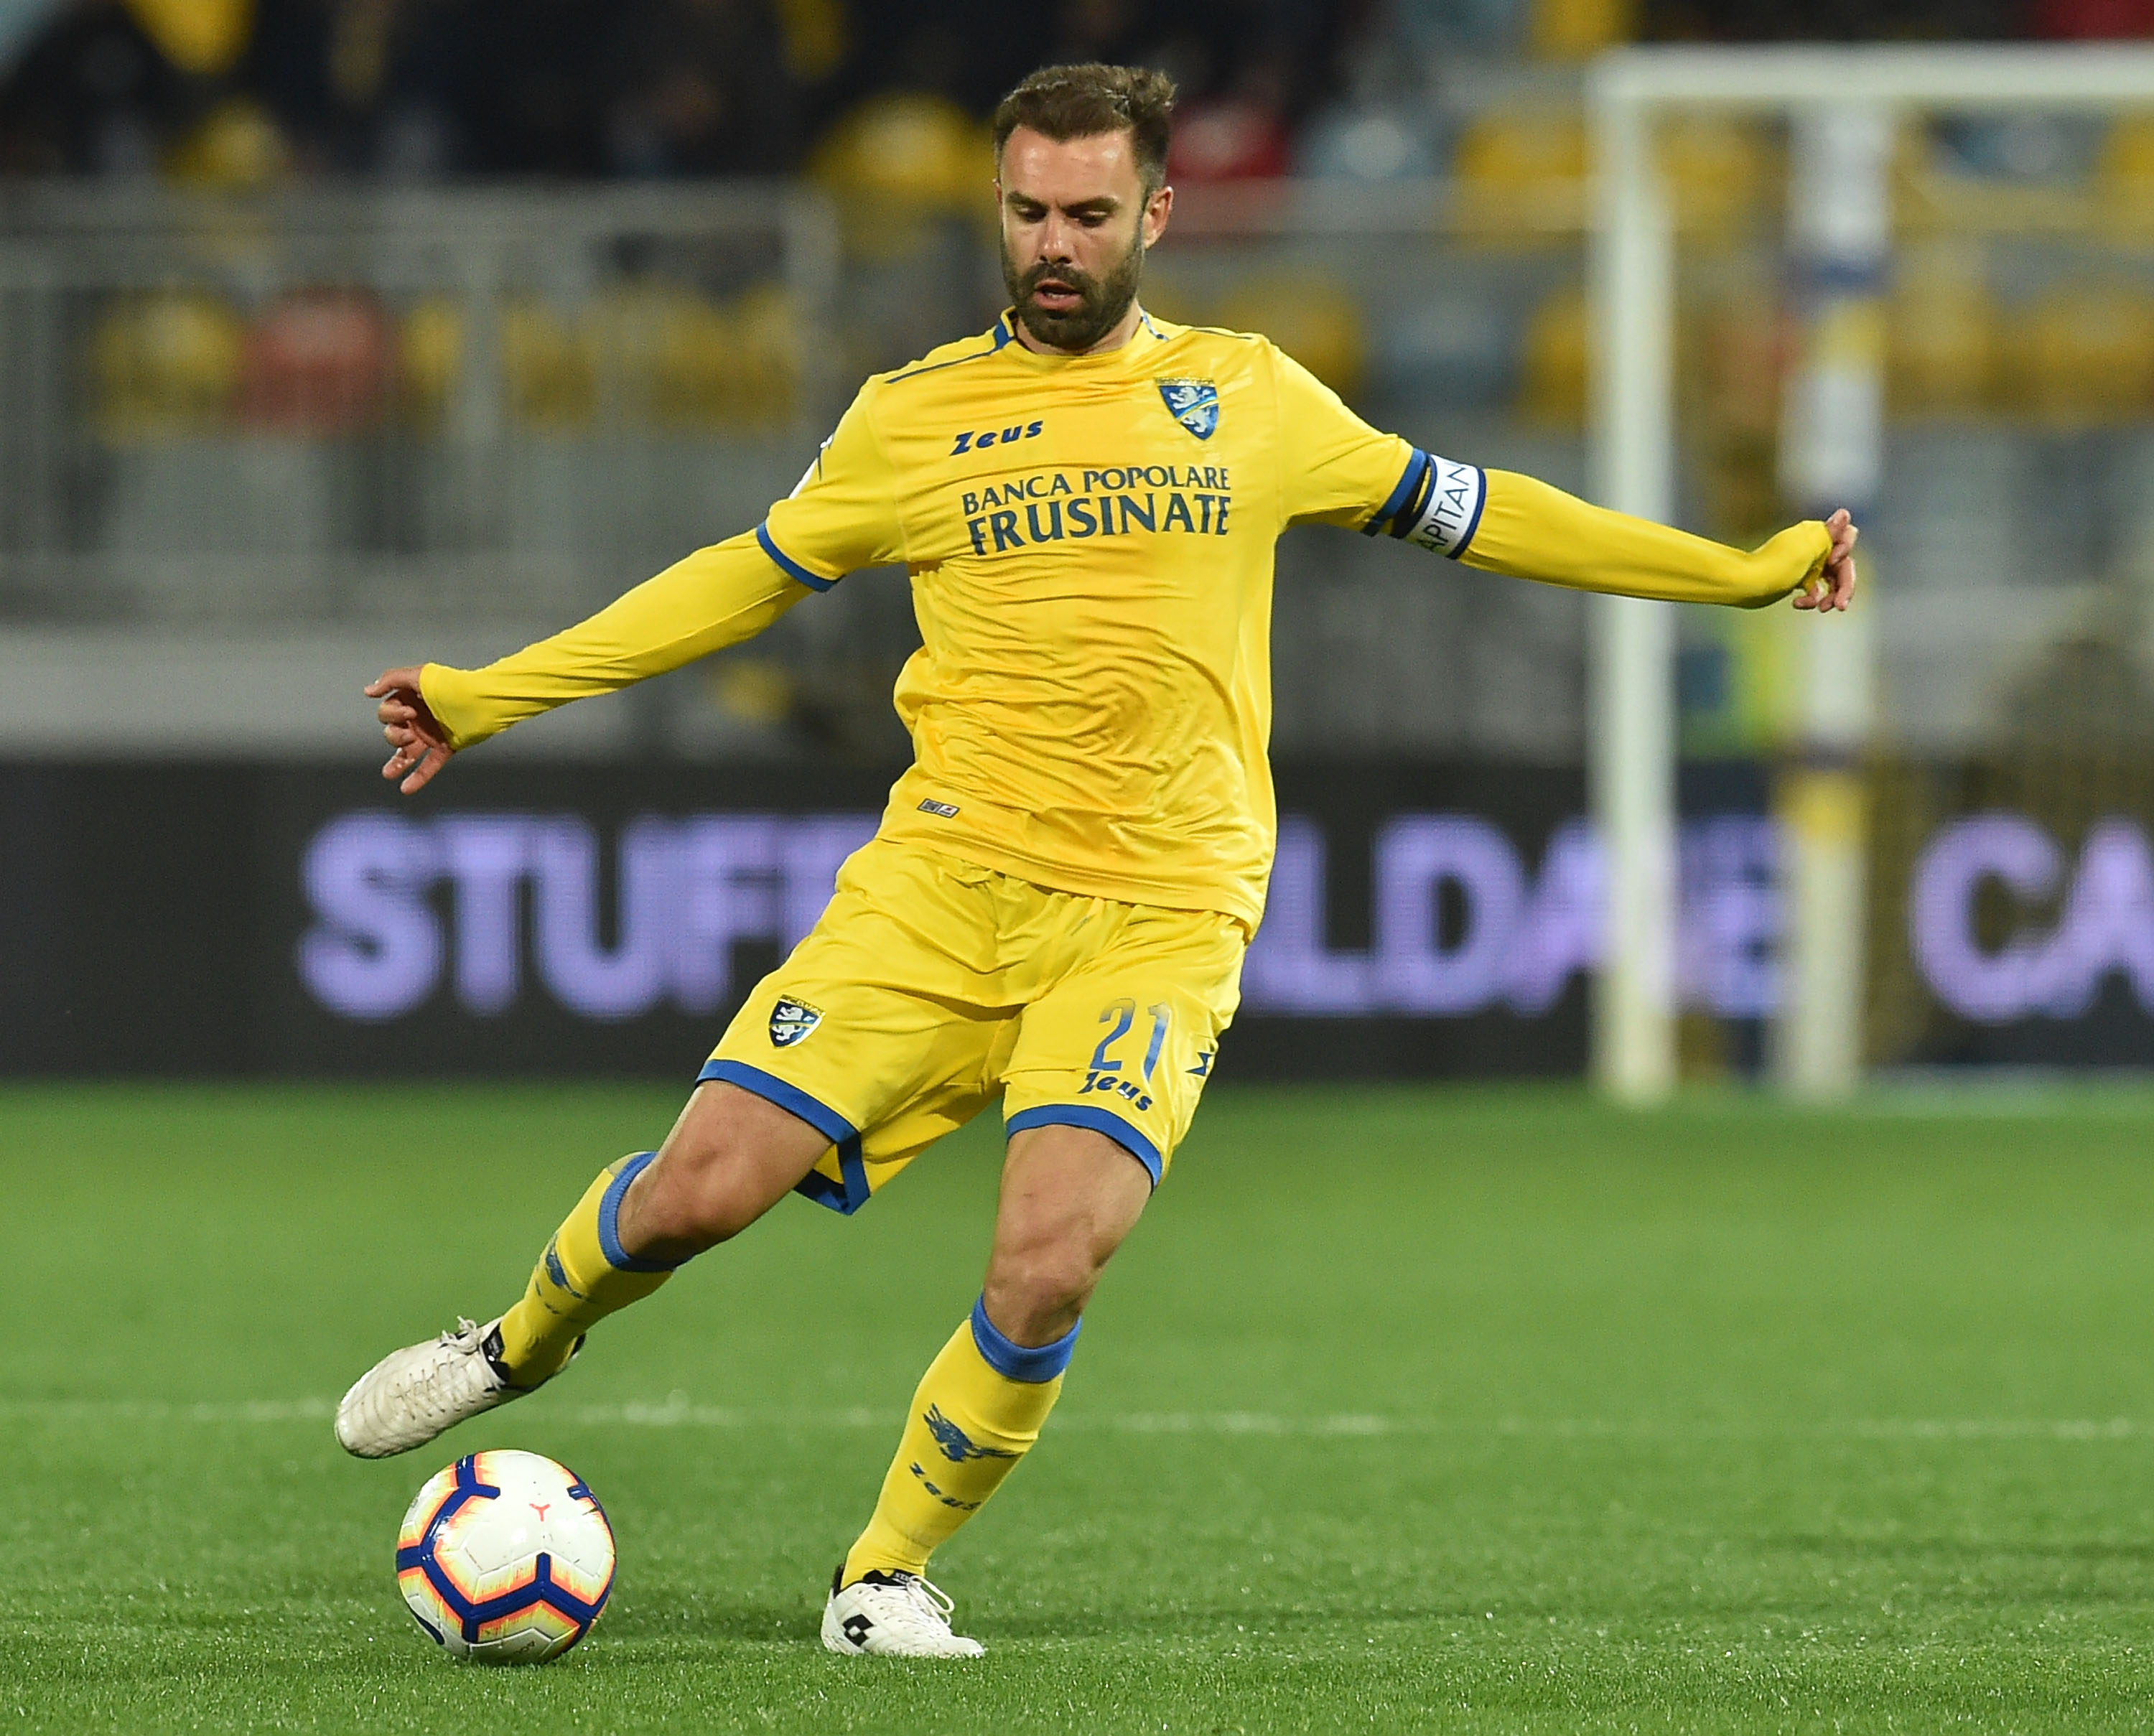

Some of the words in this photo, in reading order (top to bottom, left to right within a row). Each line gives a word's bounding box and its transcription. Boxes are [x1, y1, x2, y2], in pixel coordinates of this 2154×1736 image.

[949, 420, 1043, 456] Zeus
[961, 474, 1073, 516] BANCA
[1083, 465, 1231, 493] POPOLARE
[966, 493, 1231, 556] FRUSINATE
[1089, 997, 1172, 1084] 21
[1077, 1070, 1153, 1111] Zeus
